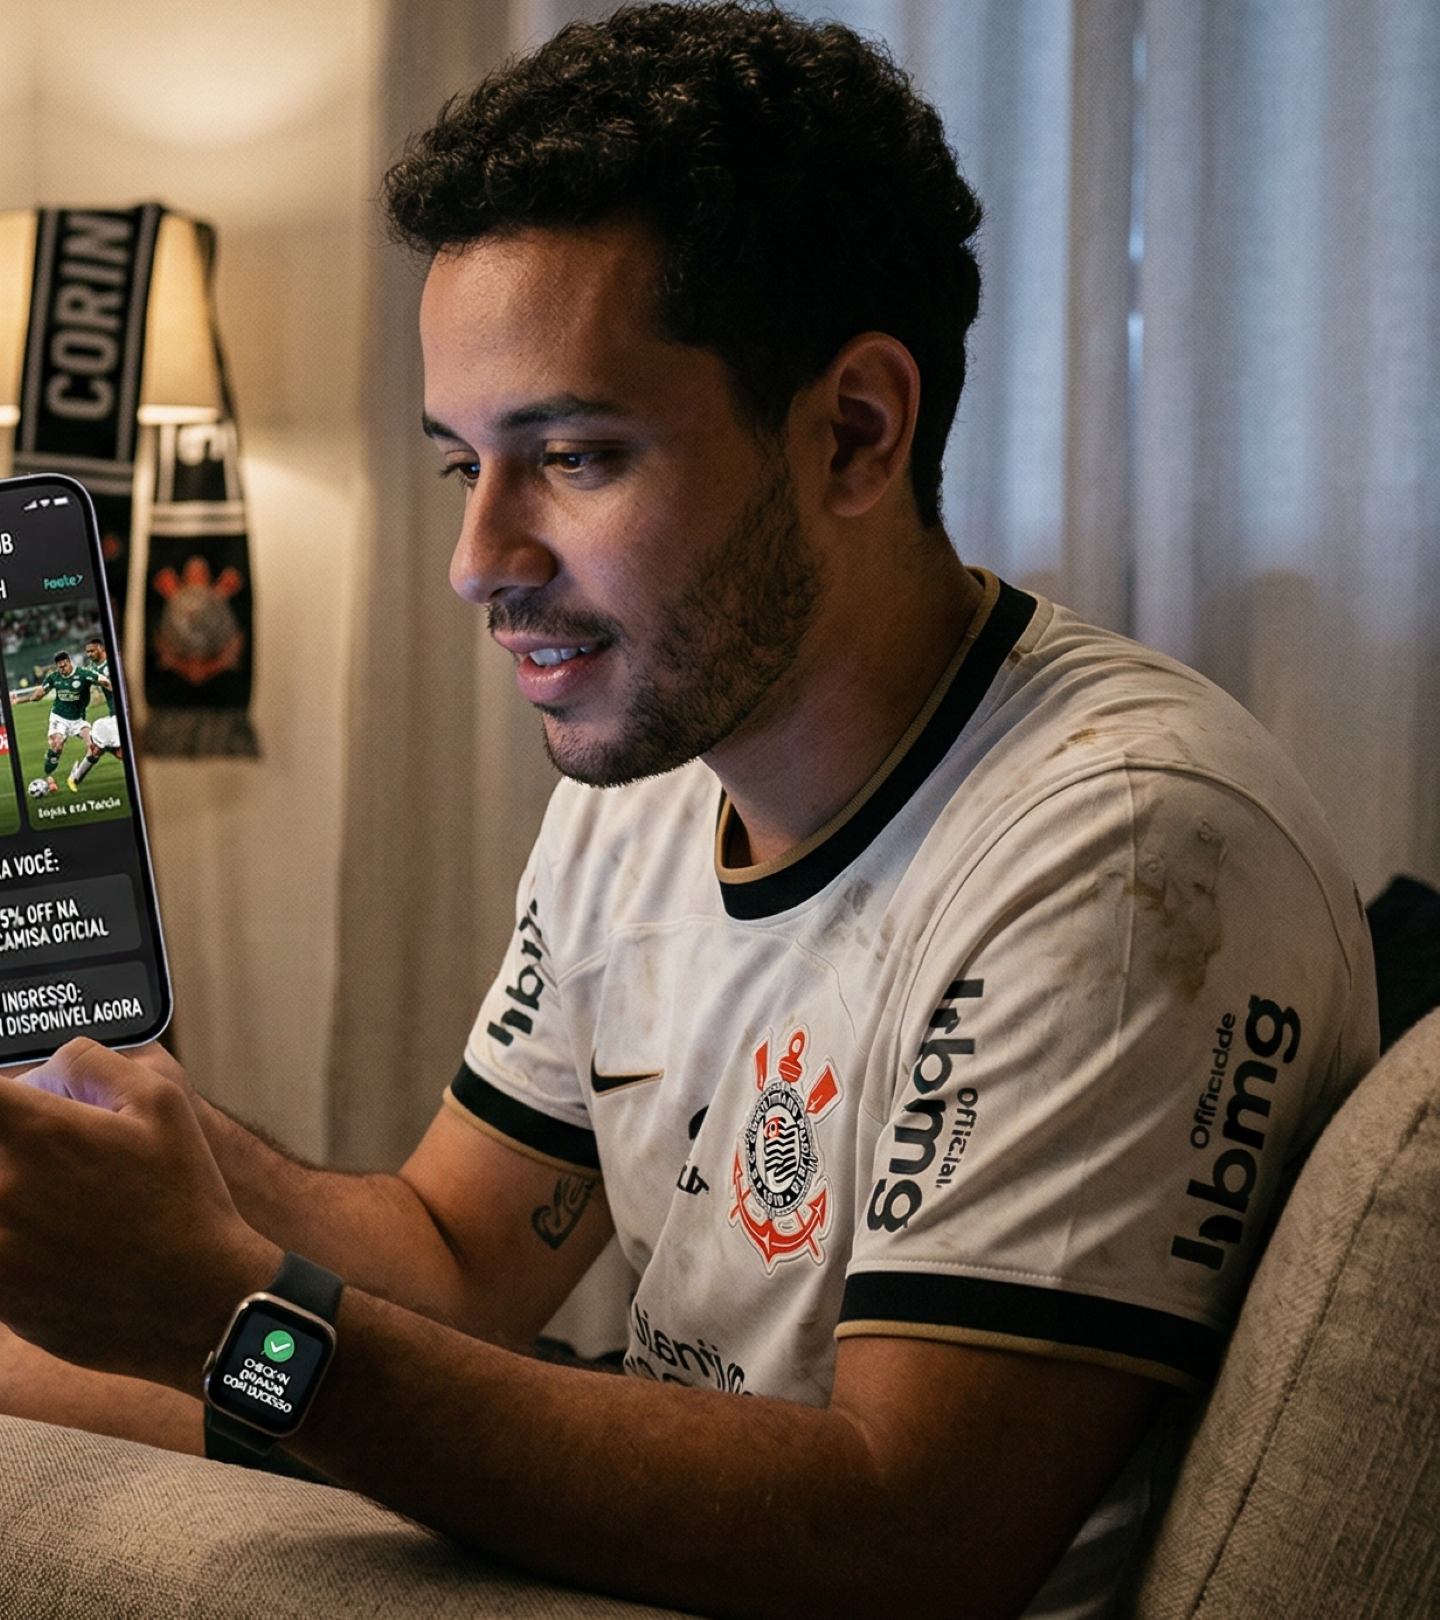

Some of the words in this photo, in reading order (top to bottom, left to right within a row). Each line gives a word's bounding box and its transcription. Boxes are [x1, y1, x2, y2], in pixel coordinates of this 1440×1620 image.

[13, 847, 61, 877] VOCÊ:
[26, 901, 54, 923] OFF
[56, 898, 80, 918] NA
[52, 918, 110, 944] OFICIAL
[1, 982, 83, 1013] INGRESSO:
[6, 1004, 92, 1036] DISPONÍVEL
[93, 997, 143, 1023] AGORA
